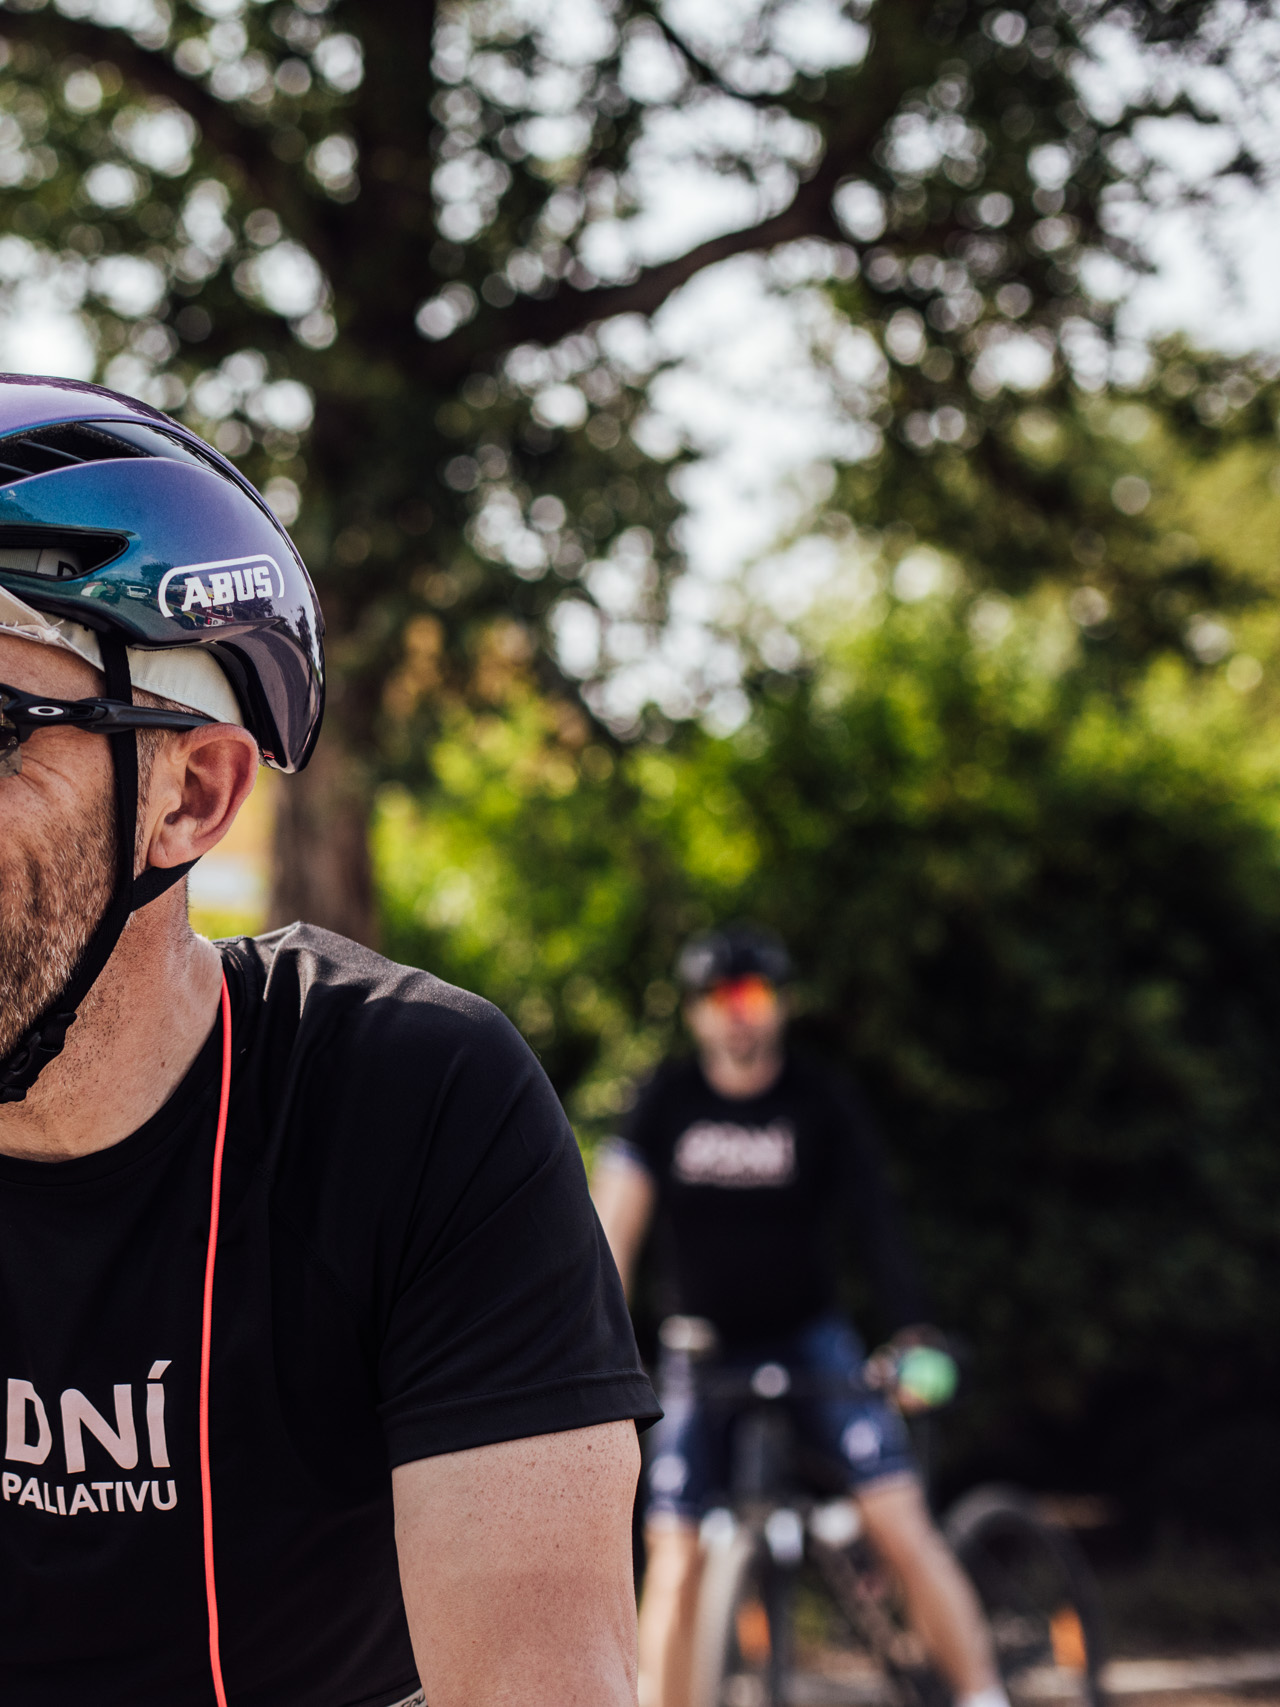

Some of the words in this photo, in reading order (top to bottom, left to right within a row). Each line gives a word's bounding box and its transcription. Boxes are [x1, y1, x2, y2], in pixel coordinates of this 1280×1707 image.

[180, 565, 273, 612] ABUS
[4, 1359, 172, 1474] DNÍ
[1, 1471, 178, 1516] PALIATIVU
